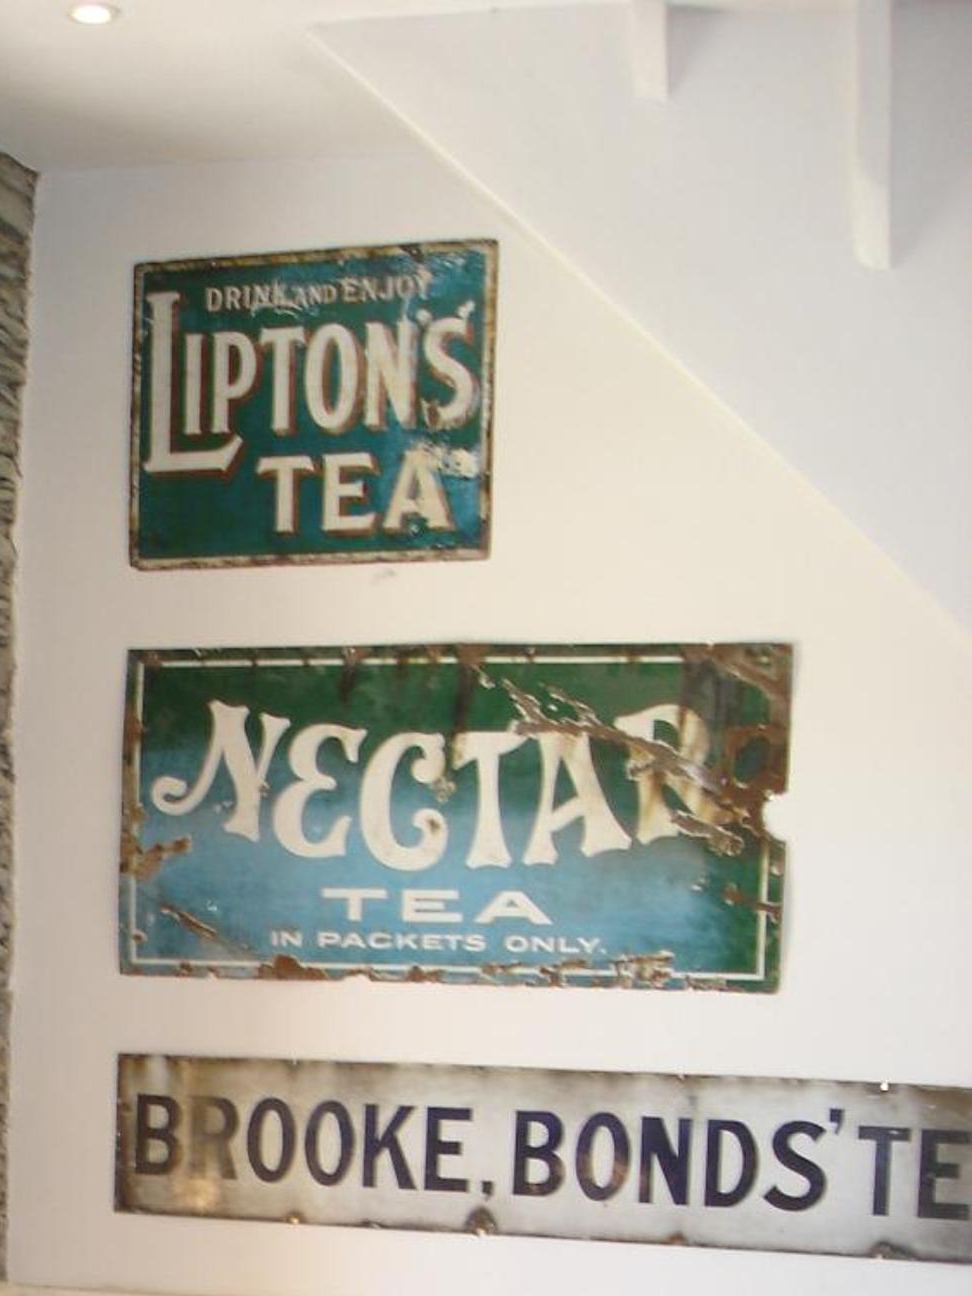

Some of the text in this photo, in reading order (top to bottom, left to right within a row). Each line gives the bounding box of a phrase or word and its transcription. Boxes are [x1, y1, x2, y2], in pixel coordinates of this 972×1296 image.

[340, 267, 433, 304] ENJOY
[256, 450, 456, 535] TEA
[150, 700, 733, 871] NECTAR
[321, 887, 553, 925] TEA
[270, 930, 304, 948] IN
[317, 931, 487, 952] PACKETS
